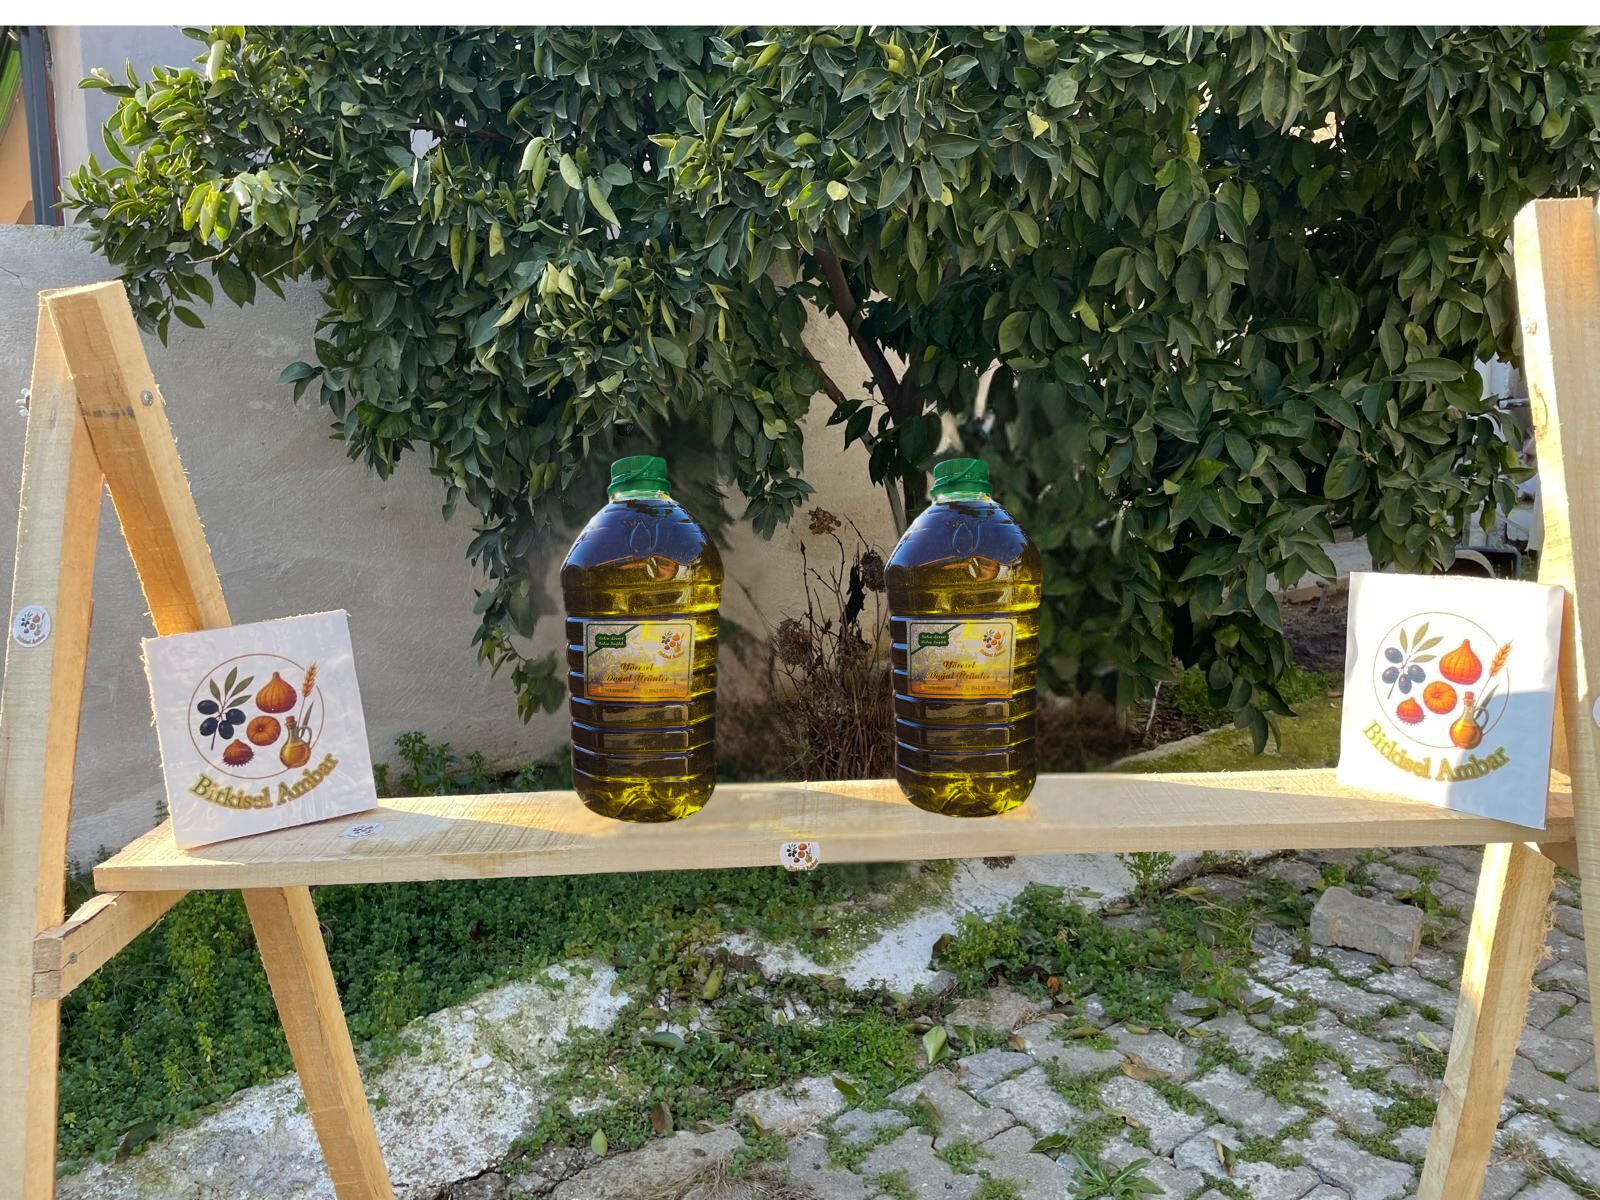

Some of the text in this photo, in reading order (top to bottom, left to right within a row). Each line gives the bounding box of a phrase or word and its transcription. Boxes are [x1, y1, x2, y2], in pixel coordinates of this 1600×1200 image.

[620, 662, 654, 672] Yöresel
[943, 660, 976, 670] Yöresel
[603, 672, 670, 683] Doğal Ürünler
[926, 670, 991, 681] Doğal Ürünler
[1362, 719, 1511, 782] Bitkisel Ambar
[189, 752, 339, 809] Bitkisel Ambar
